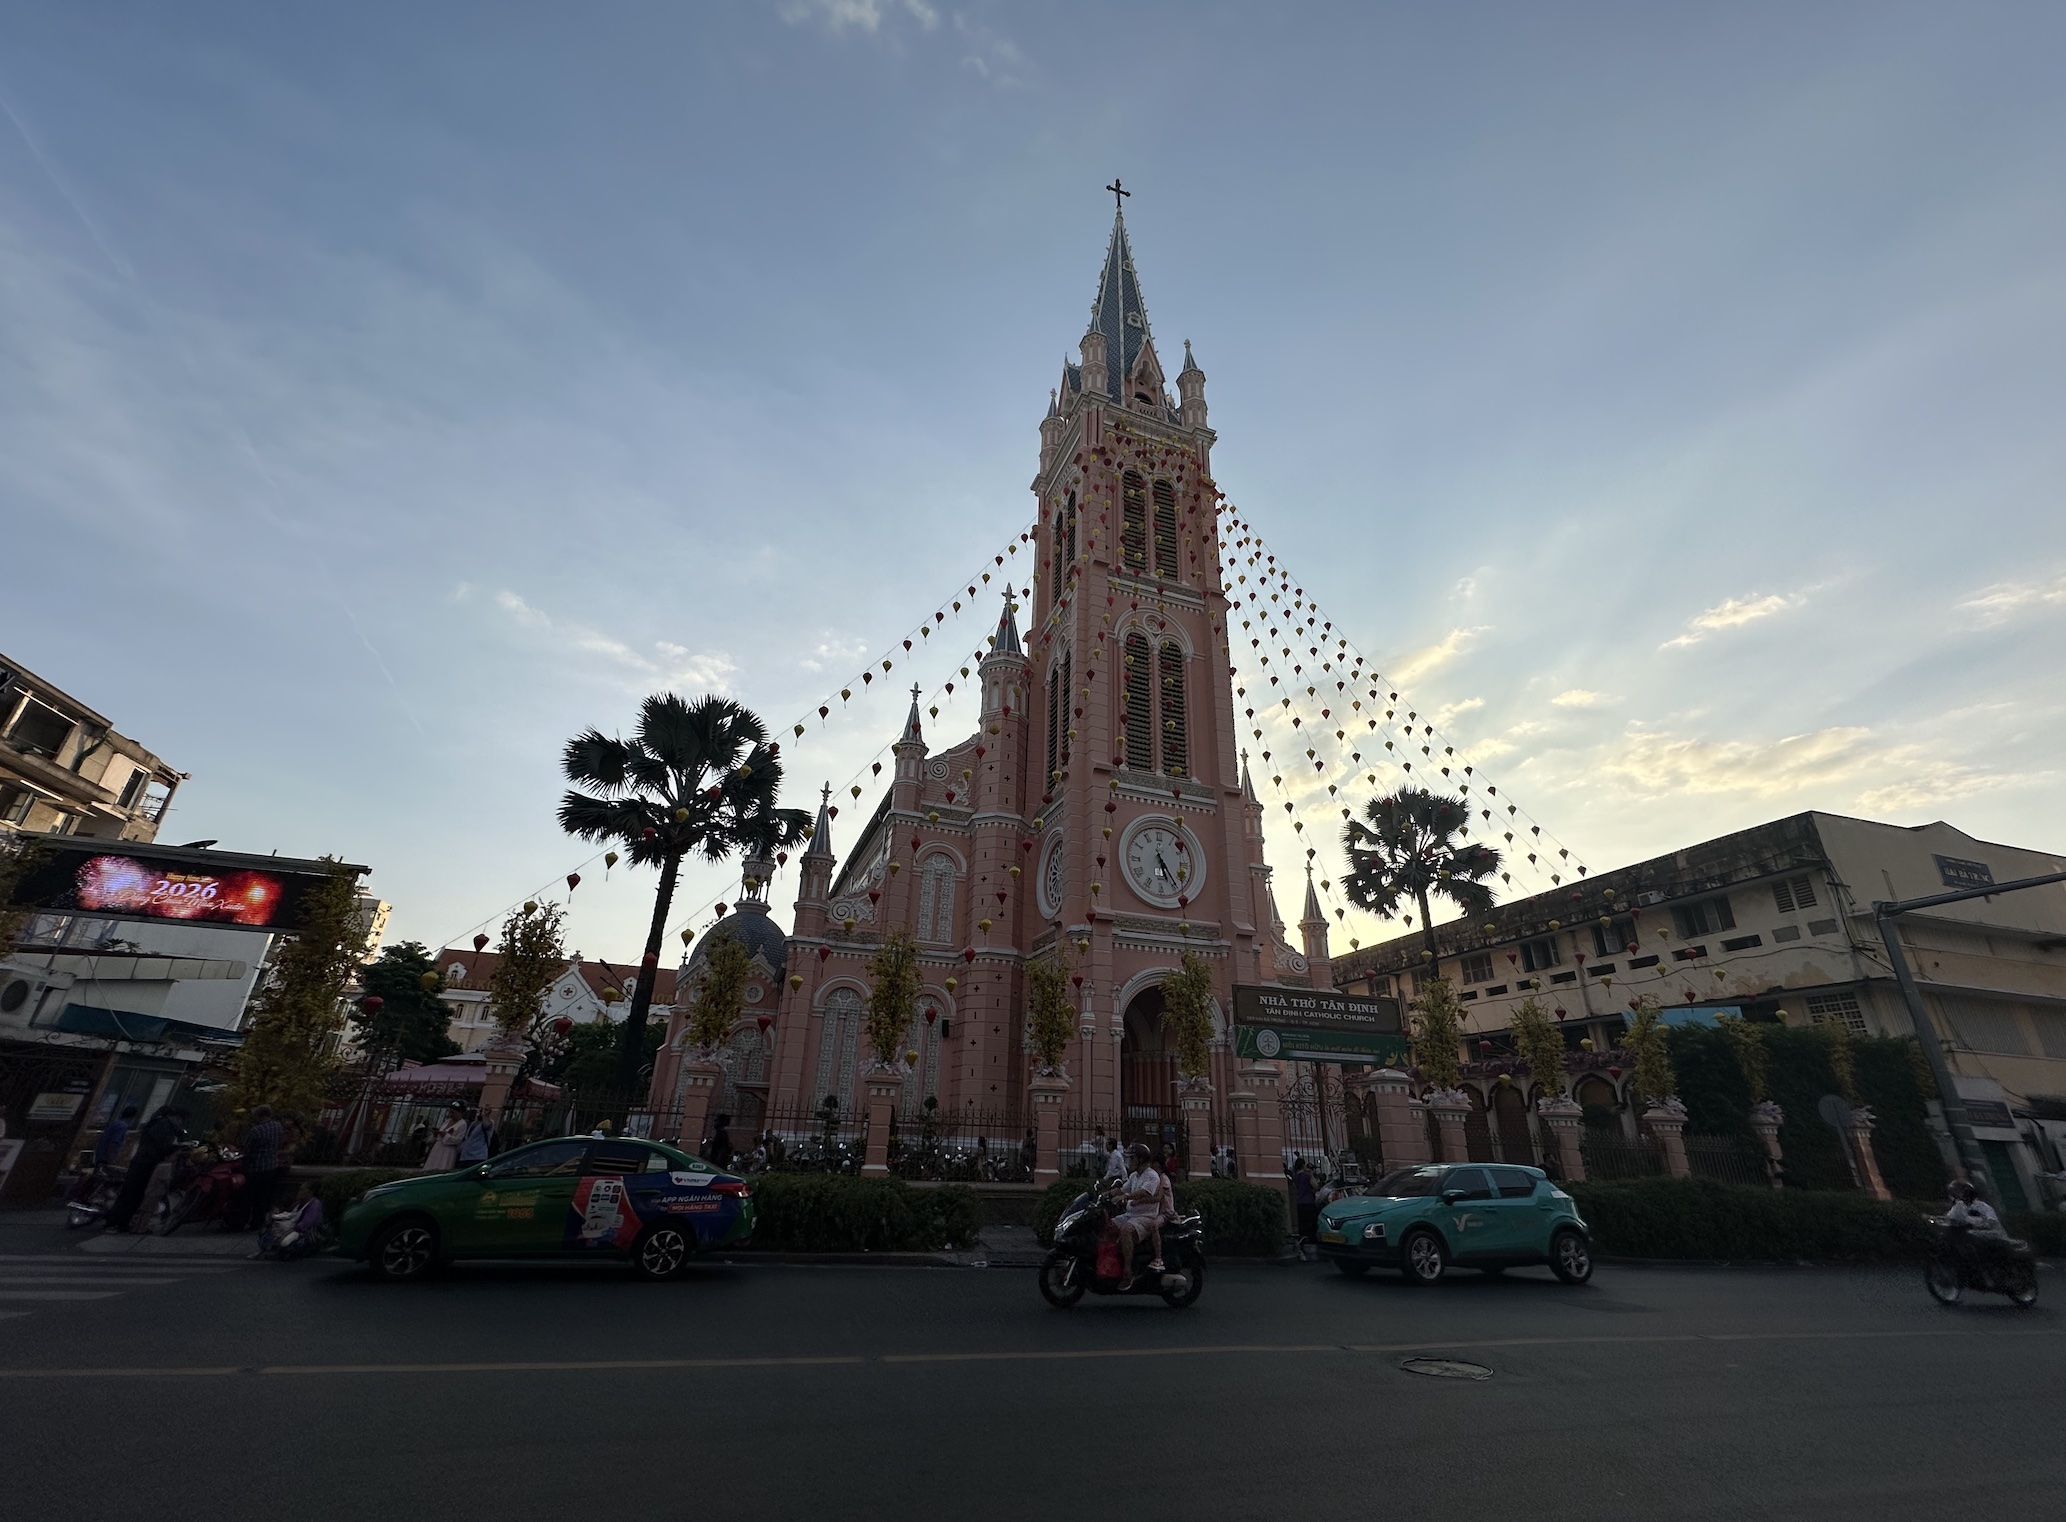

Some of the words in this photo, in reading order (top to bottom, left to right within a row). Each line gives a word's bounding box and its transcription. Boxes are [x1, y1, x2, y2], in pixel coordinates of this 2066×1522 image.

[150, 881, 219, 899] 2026
[1259, 995, 1288, 1007] NHÀ
[1290, 997, 1317, 1009] THỜ
[1320, 1000, 1345, 1011] TÂN
[1348, 1003, 1379, 1014] ĐỊNH
[1304, 1011, 1341, 1020] CATHOLIC
[1343, 1014, 1375, 1022] CHURCH
